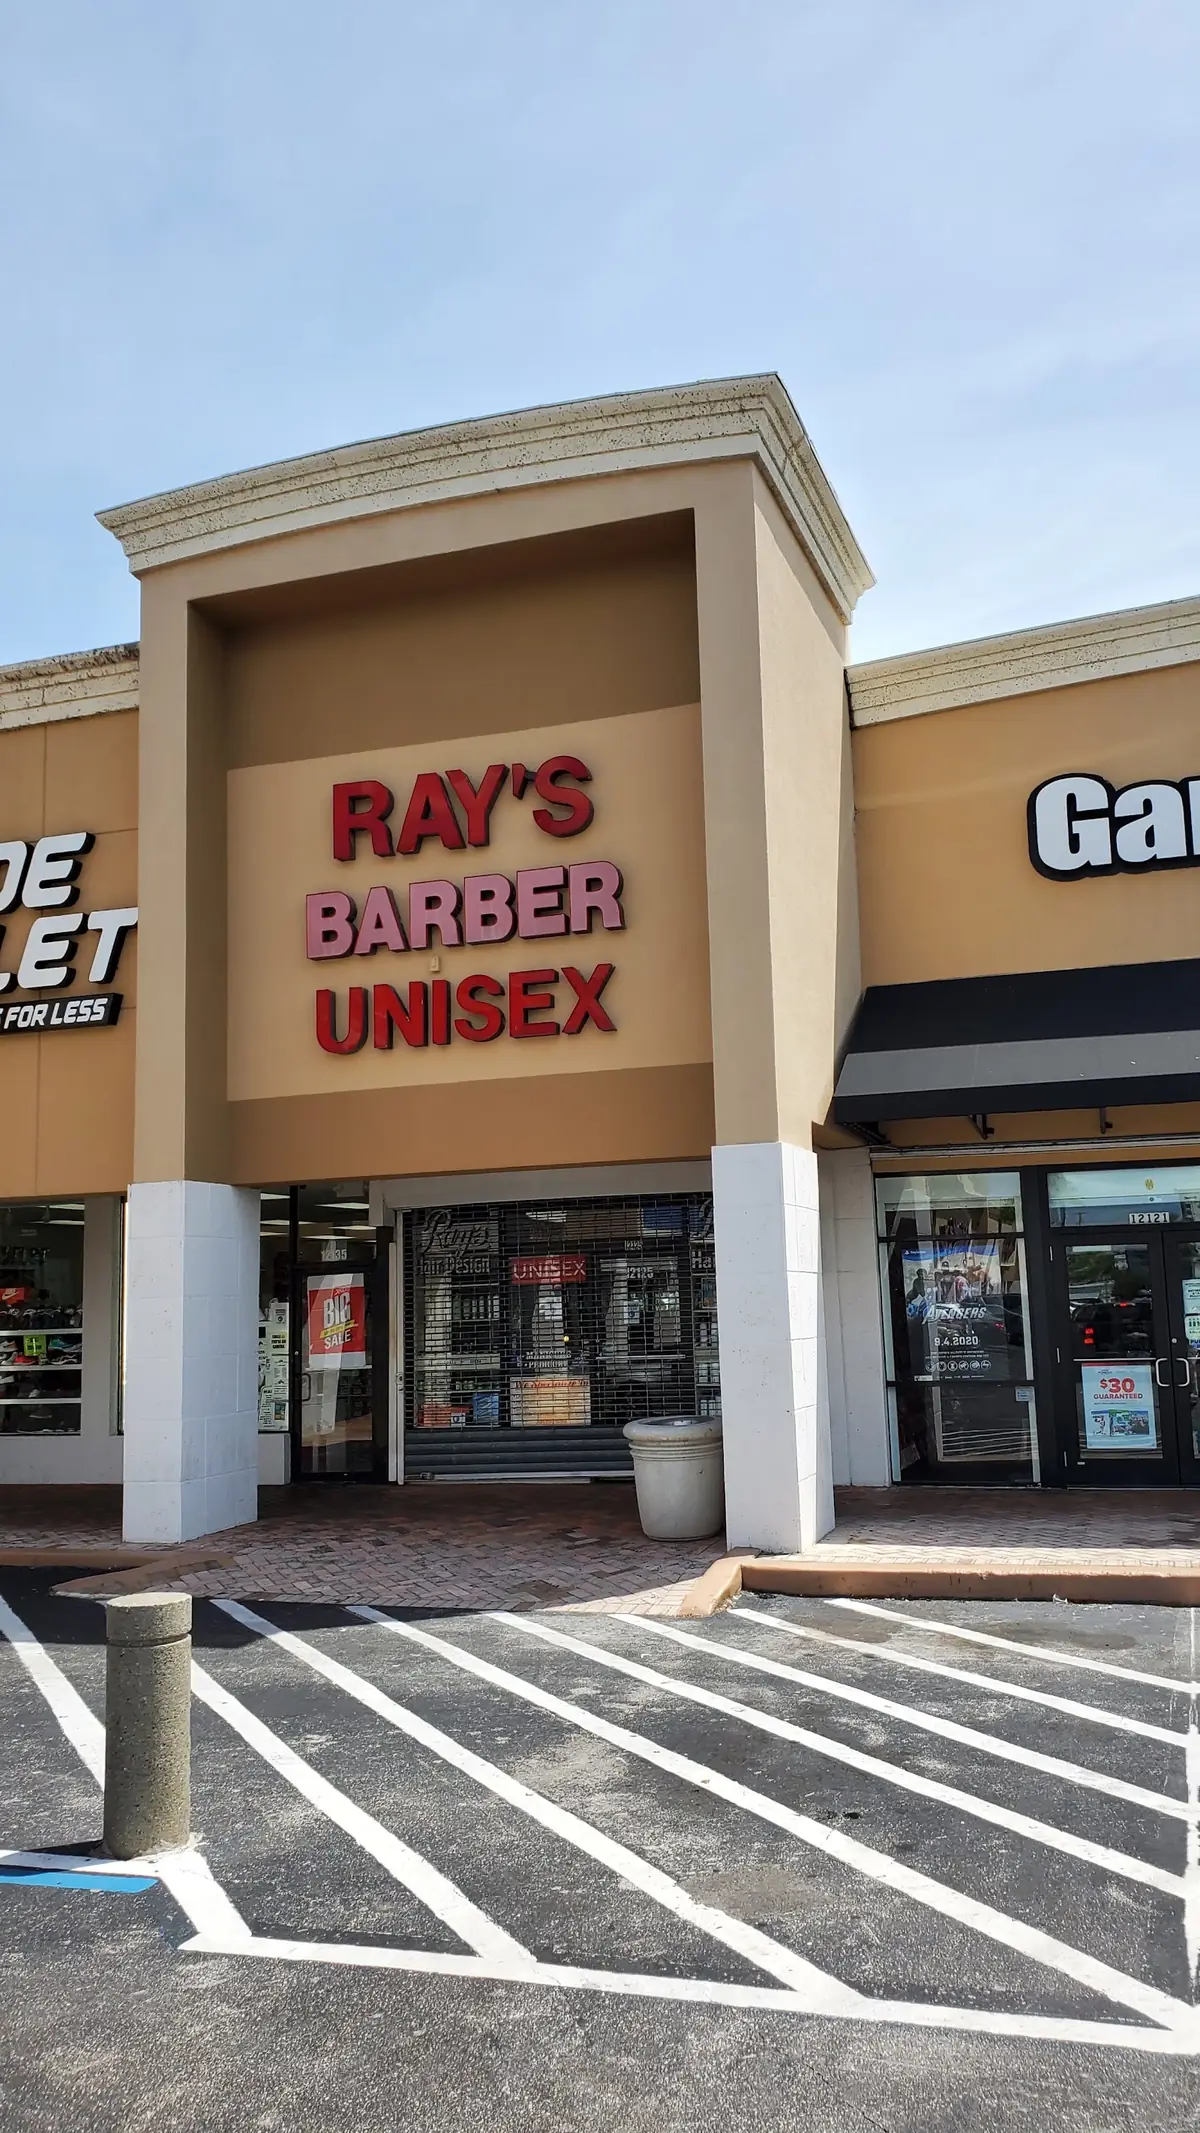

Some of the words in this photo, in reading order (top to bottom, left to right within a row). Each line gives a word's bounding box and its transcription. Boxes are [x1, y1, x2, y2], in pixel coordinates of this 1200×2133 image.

[332, 755, 593, 861] RAY'S
[1030, 774, 1200, 878] Ga
[305, 860, 625, 960] BARBER
[0, 907, 138, 993] ET
[4, 1004, 49, 1029] FOR
[50, 997, 109, 1024] LESS
[315, 962, 618, 1055] UNISEX
[1130, 1212, 1169, 1224] 12121
[513, 1259, 586, 1279] UNISEX
[323, 1291, 351, 1329] BIG
[324, 1329, 352, 1350] SALE
[1093, 1392, 1144, 1400] GUARANTEED
[1100, 1377, 1135, 1393] $30
